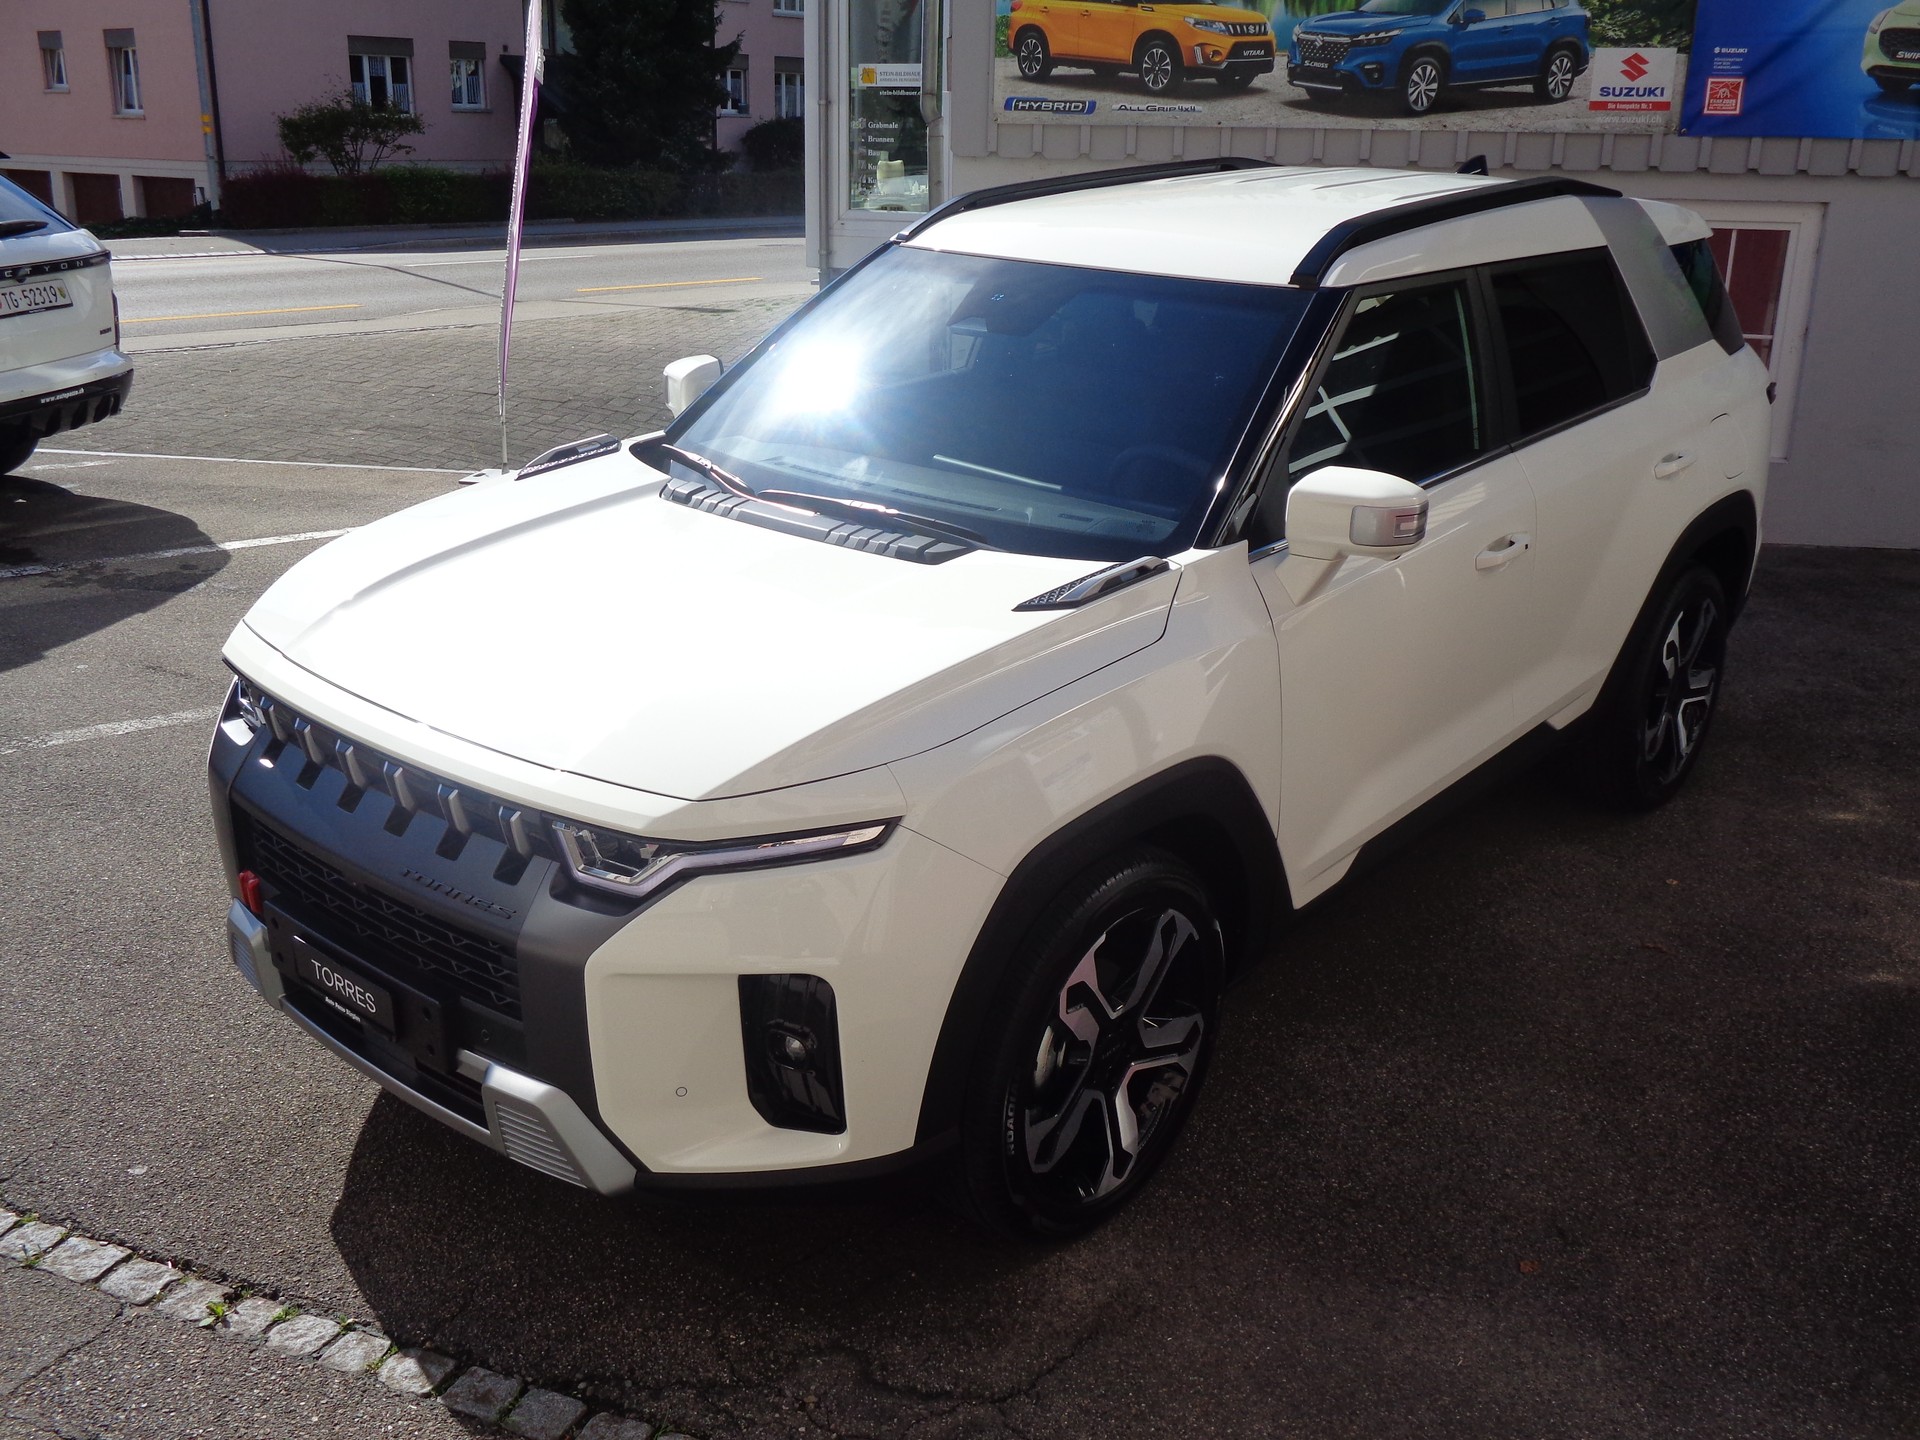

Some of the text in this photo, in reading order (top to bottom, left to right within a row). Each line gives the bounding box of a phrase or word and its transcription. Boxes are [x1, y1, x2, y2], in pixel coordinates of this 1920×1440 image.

[1304, 60, 1329, 69] S-CROSS
[1599, 86, 1665, 98] SUZUKI
[867, 121, 899, 129] Grabmale
[867, 135, 895, 143] Brunnen
[401, 867, 517, 920] TORRES
[311, 959, 376, 1013] TORRES
